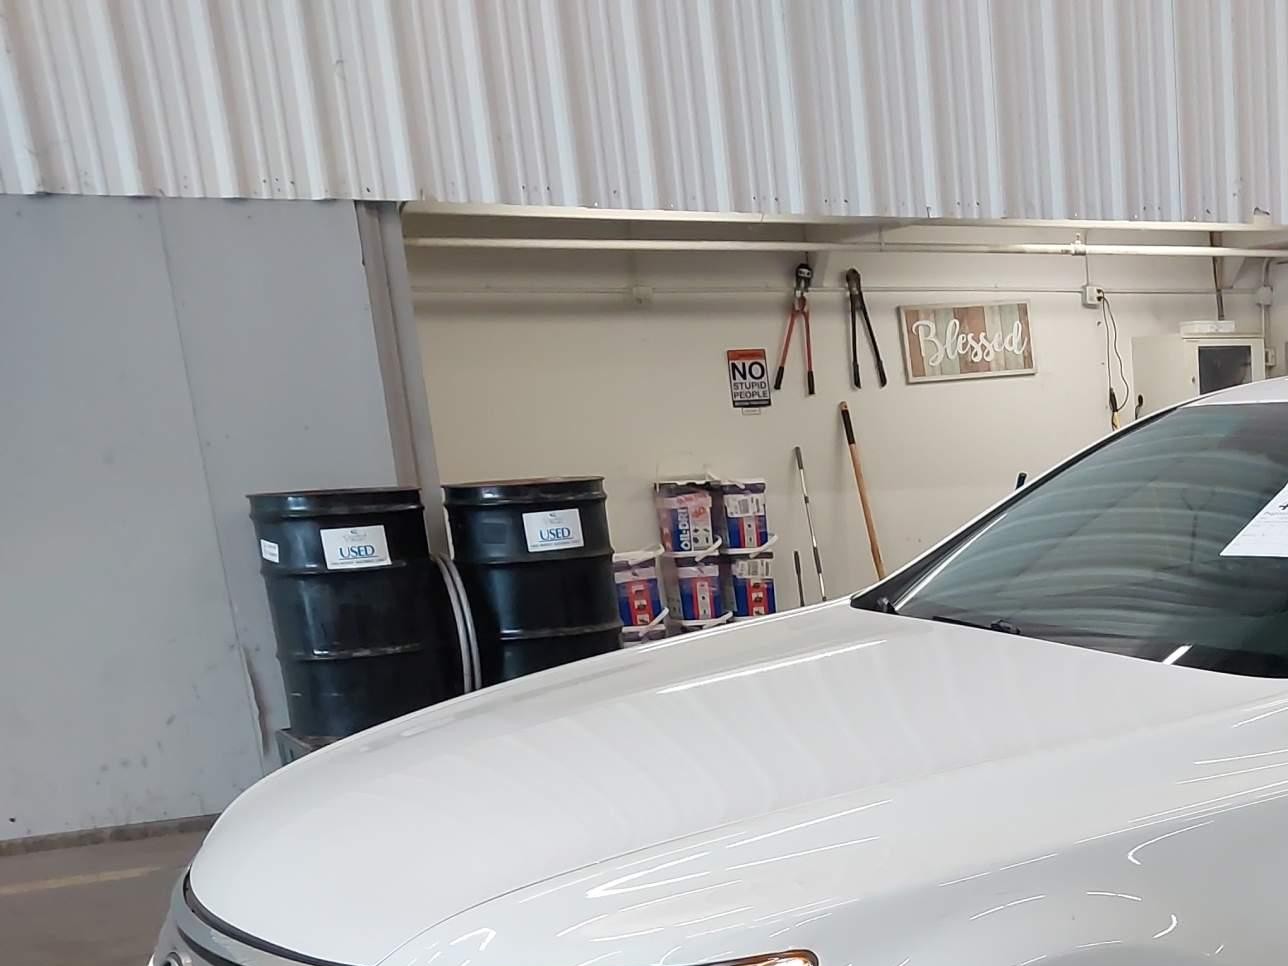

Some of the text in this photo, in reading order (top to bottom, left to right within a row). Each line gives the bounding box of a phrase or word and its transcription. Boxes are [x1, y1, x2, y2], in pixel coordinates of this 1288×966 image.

[912, 319, 1028, 366] Blessed
[731, 361, 766, 381] NO
[733, 381, 767, 391] STUPID
[733, 390, 769, 399] PEOPLE
[540, 527, 571, 541] USED
[339, 544, 375, 559] USED
